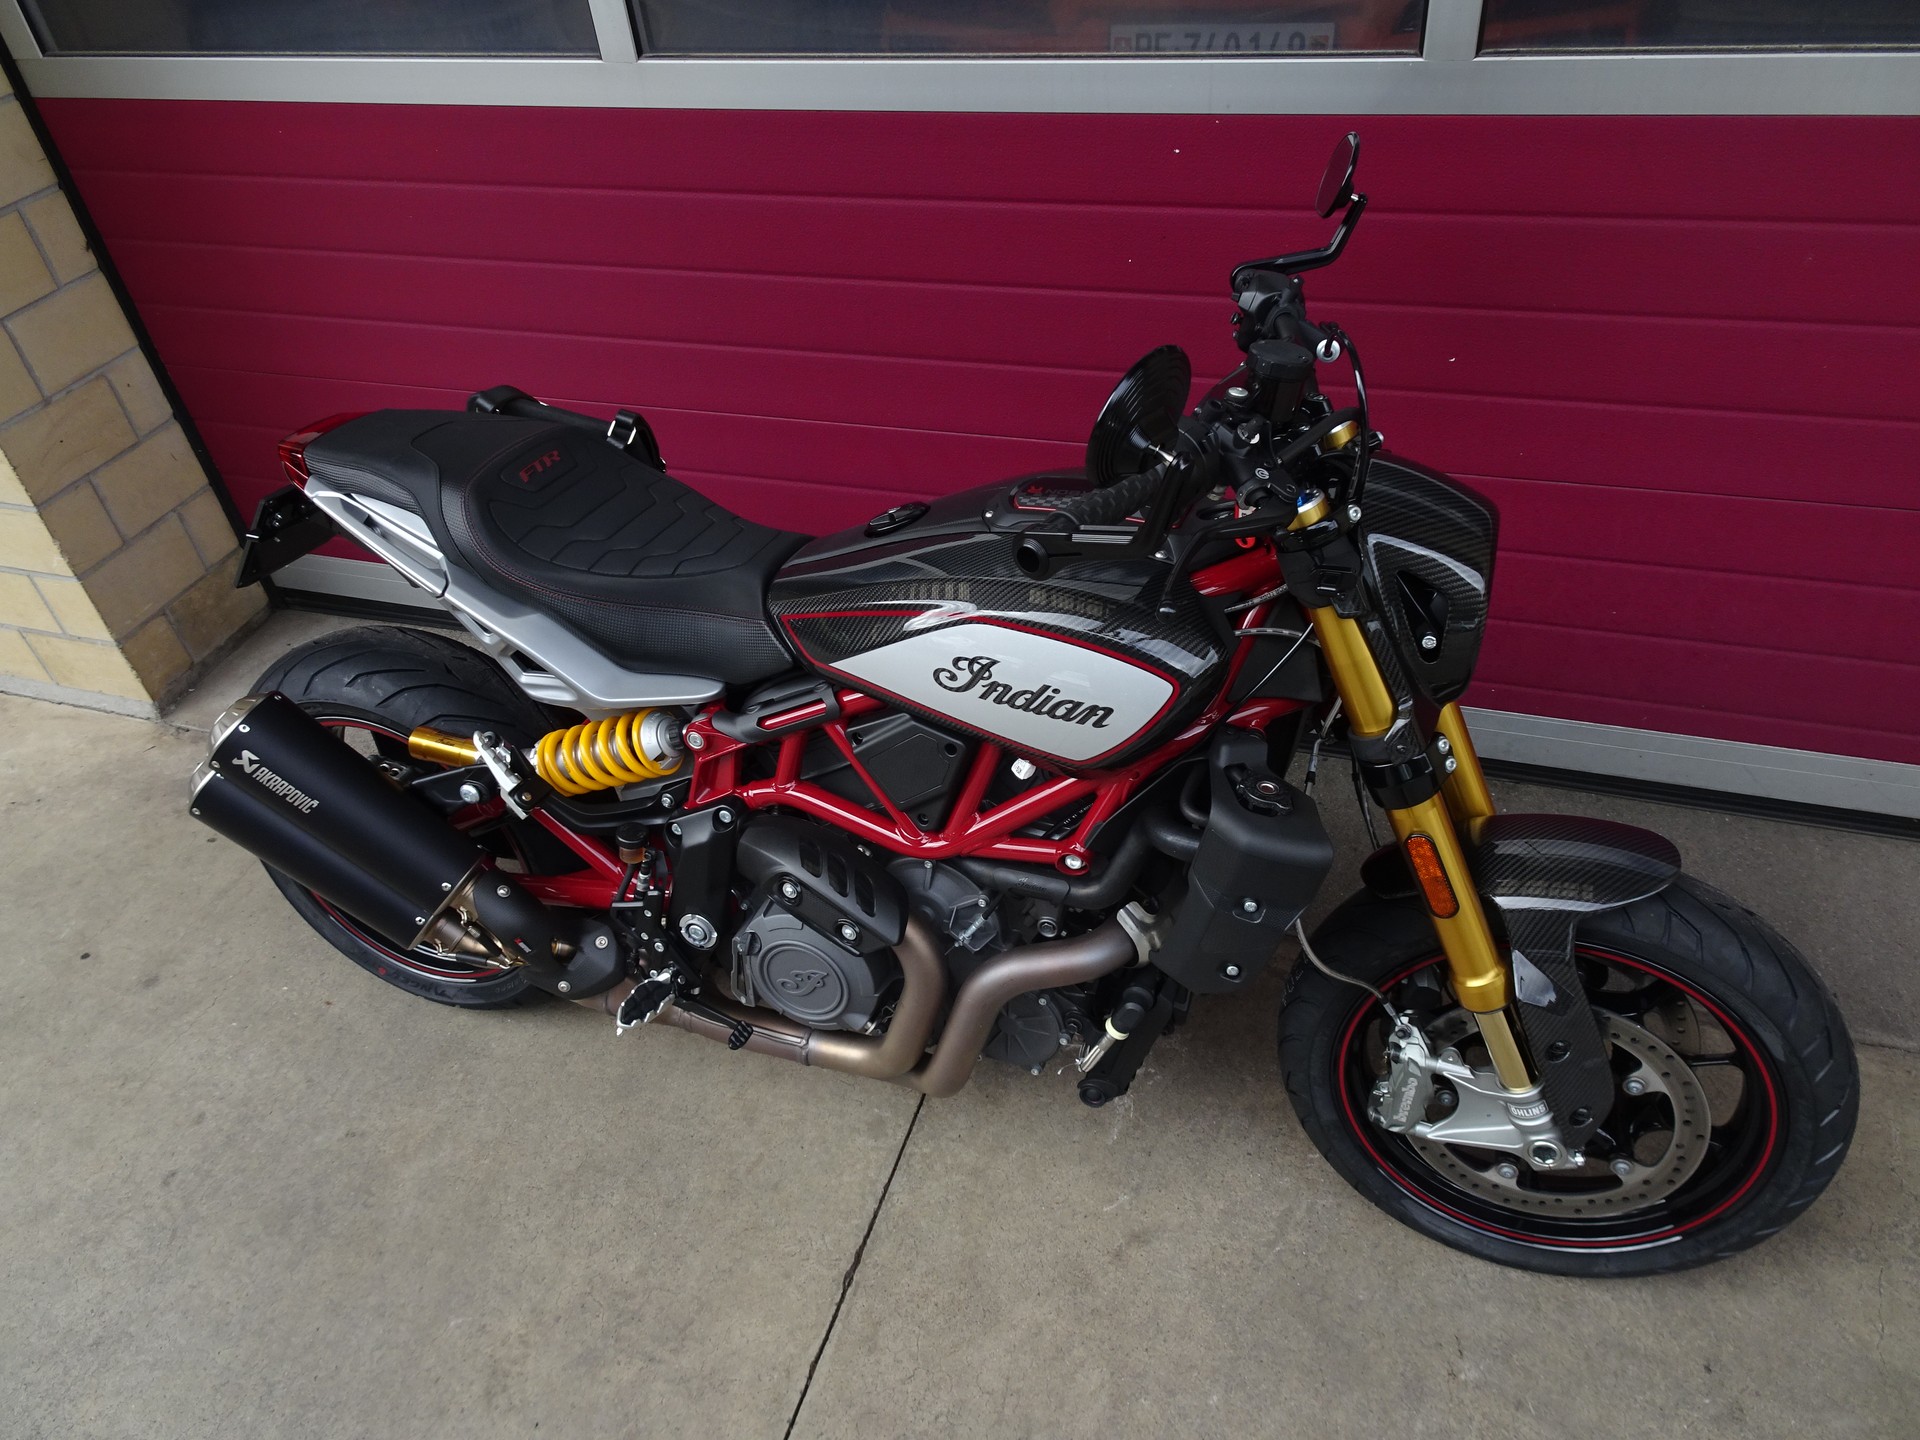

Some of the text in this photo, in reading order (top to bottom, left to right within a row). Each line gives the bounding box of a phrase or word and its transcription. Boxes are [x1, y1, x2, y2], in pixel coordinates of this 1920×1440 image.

[519, 450, 561, 483] FTR
[932, 655, 1115, 729] Indian
[1392, 1077, 1419, 1123] brembo
